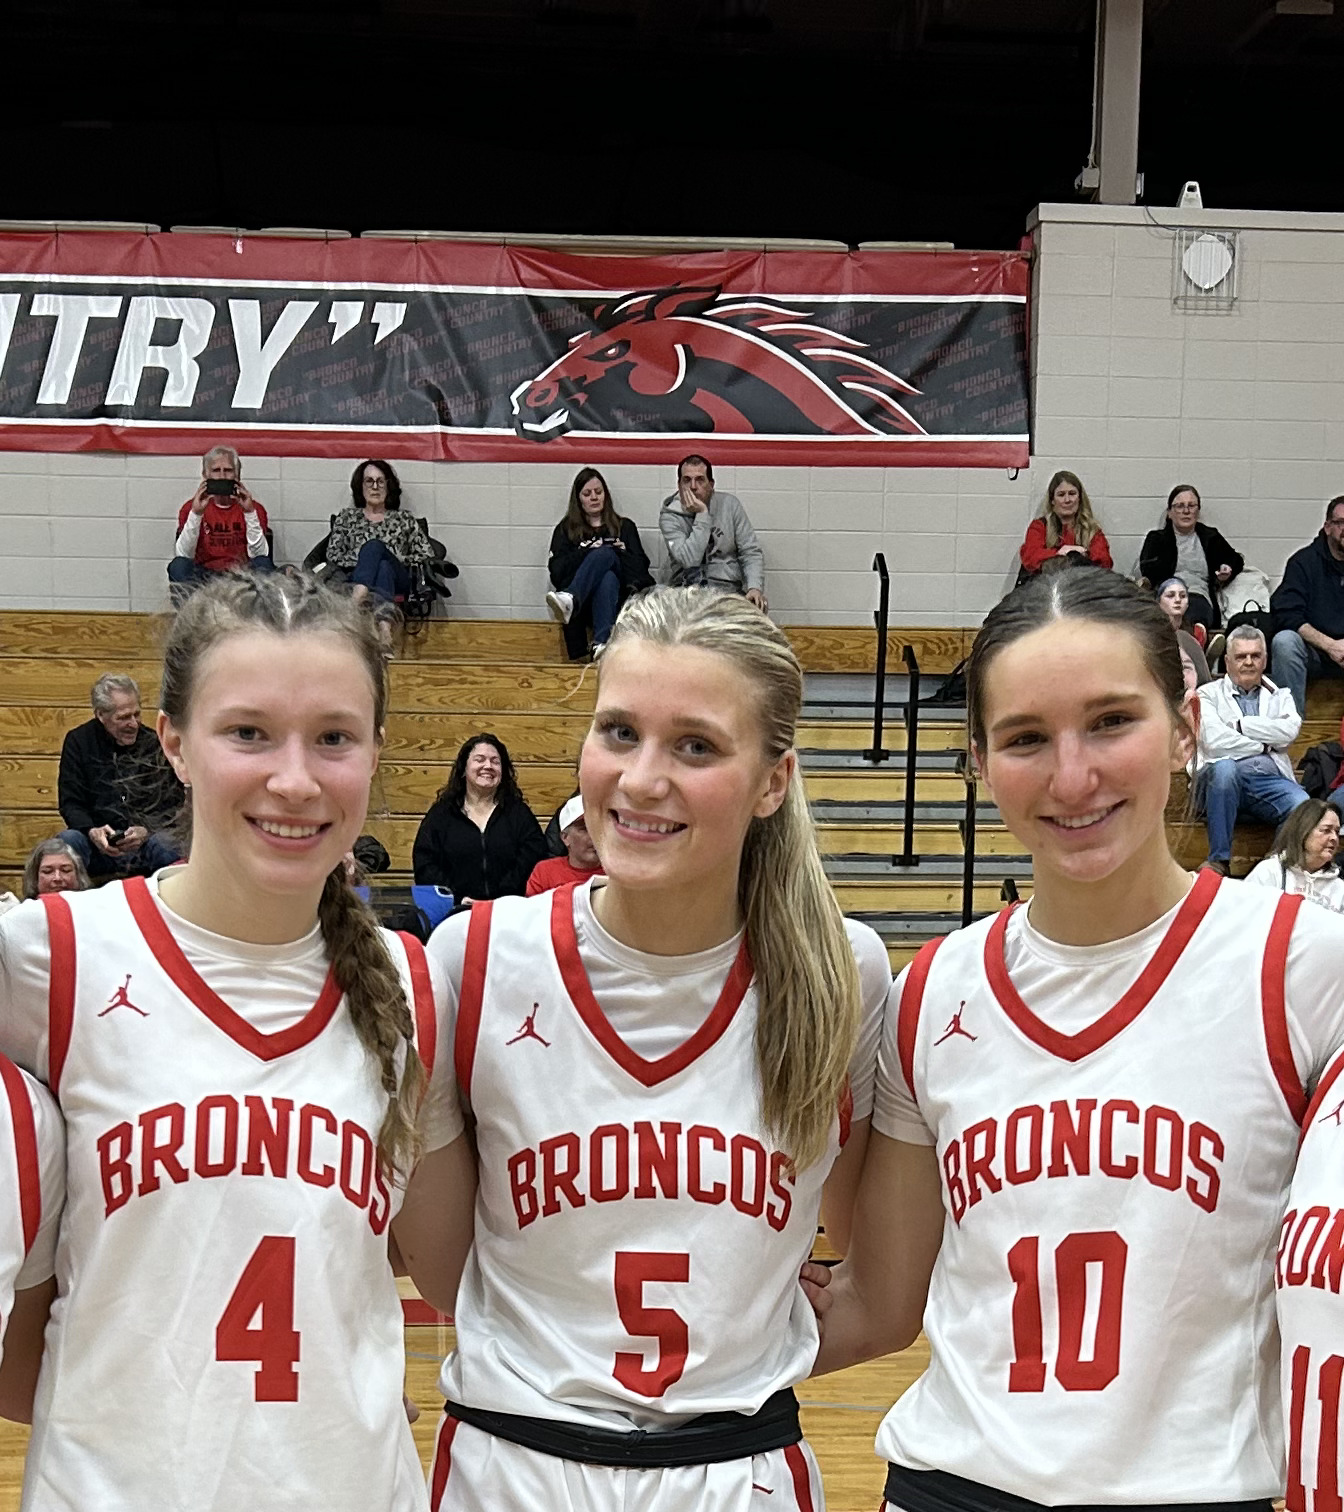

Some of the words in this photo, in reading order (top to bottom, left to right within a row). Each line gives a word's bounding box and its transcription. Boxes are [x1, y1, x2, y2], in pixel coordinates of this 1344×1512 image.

[95, 1093, 394, 1237] BRONCOS
[507, 1120, 797, 1233] BRONCOS
[943, 1097, 1226, 1233] BRONCOS
[215, 1235, 302, 1403] 4
[611, 1251, 690, 1399] 5
[1006, 1230, 1129, 1393] 10
